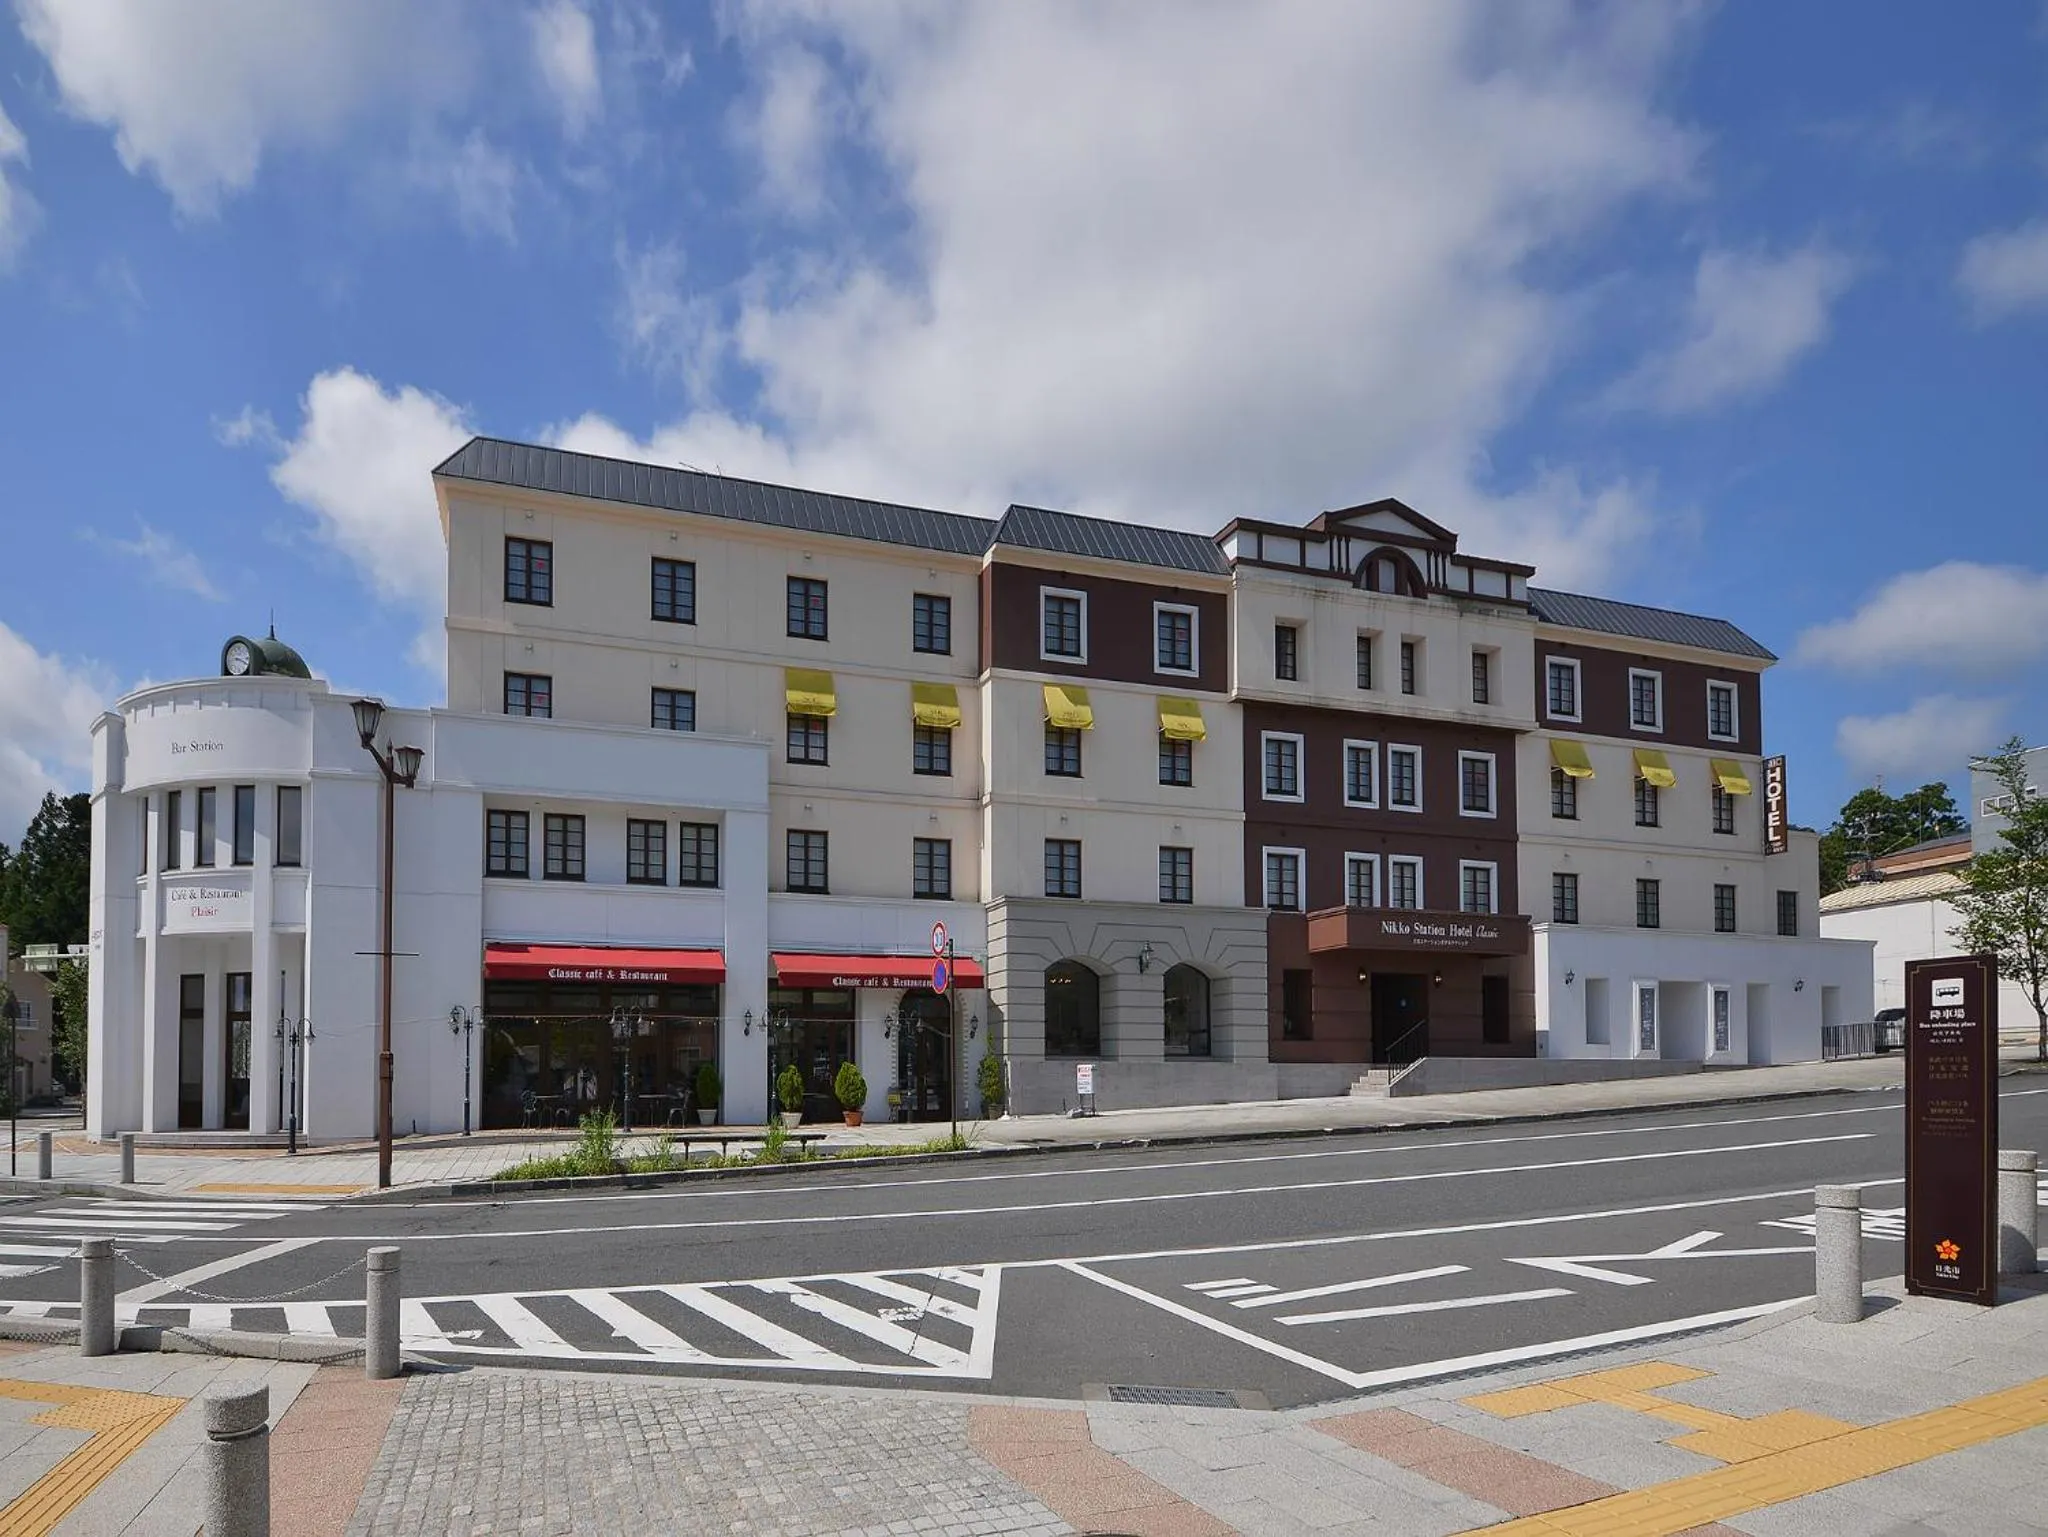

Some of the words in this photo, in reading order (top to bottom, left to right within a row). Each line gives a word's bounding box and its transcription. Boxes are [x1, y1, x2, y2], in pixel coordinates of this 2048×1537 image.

[171, 742, 187, 754] Bar
[189, 740, 224, 752] Station
[1766, 767, 1781, 842] HOTEL
[189, 889, 197, 899] &
[1381, 921, 1410, 934] Nikko
[1413, 922, 1445, 936] Station
[1449, 924, 1473, 937] Hotel
[548, 968, 582, 978] Classic
[606, 970, 615, 980] &
[619, 970, 668, 981] Restaurant
[832, 976, 861, 986] Classic
[881, 977, 889, 987] &
